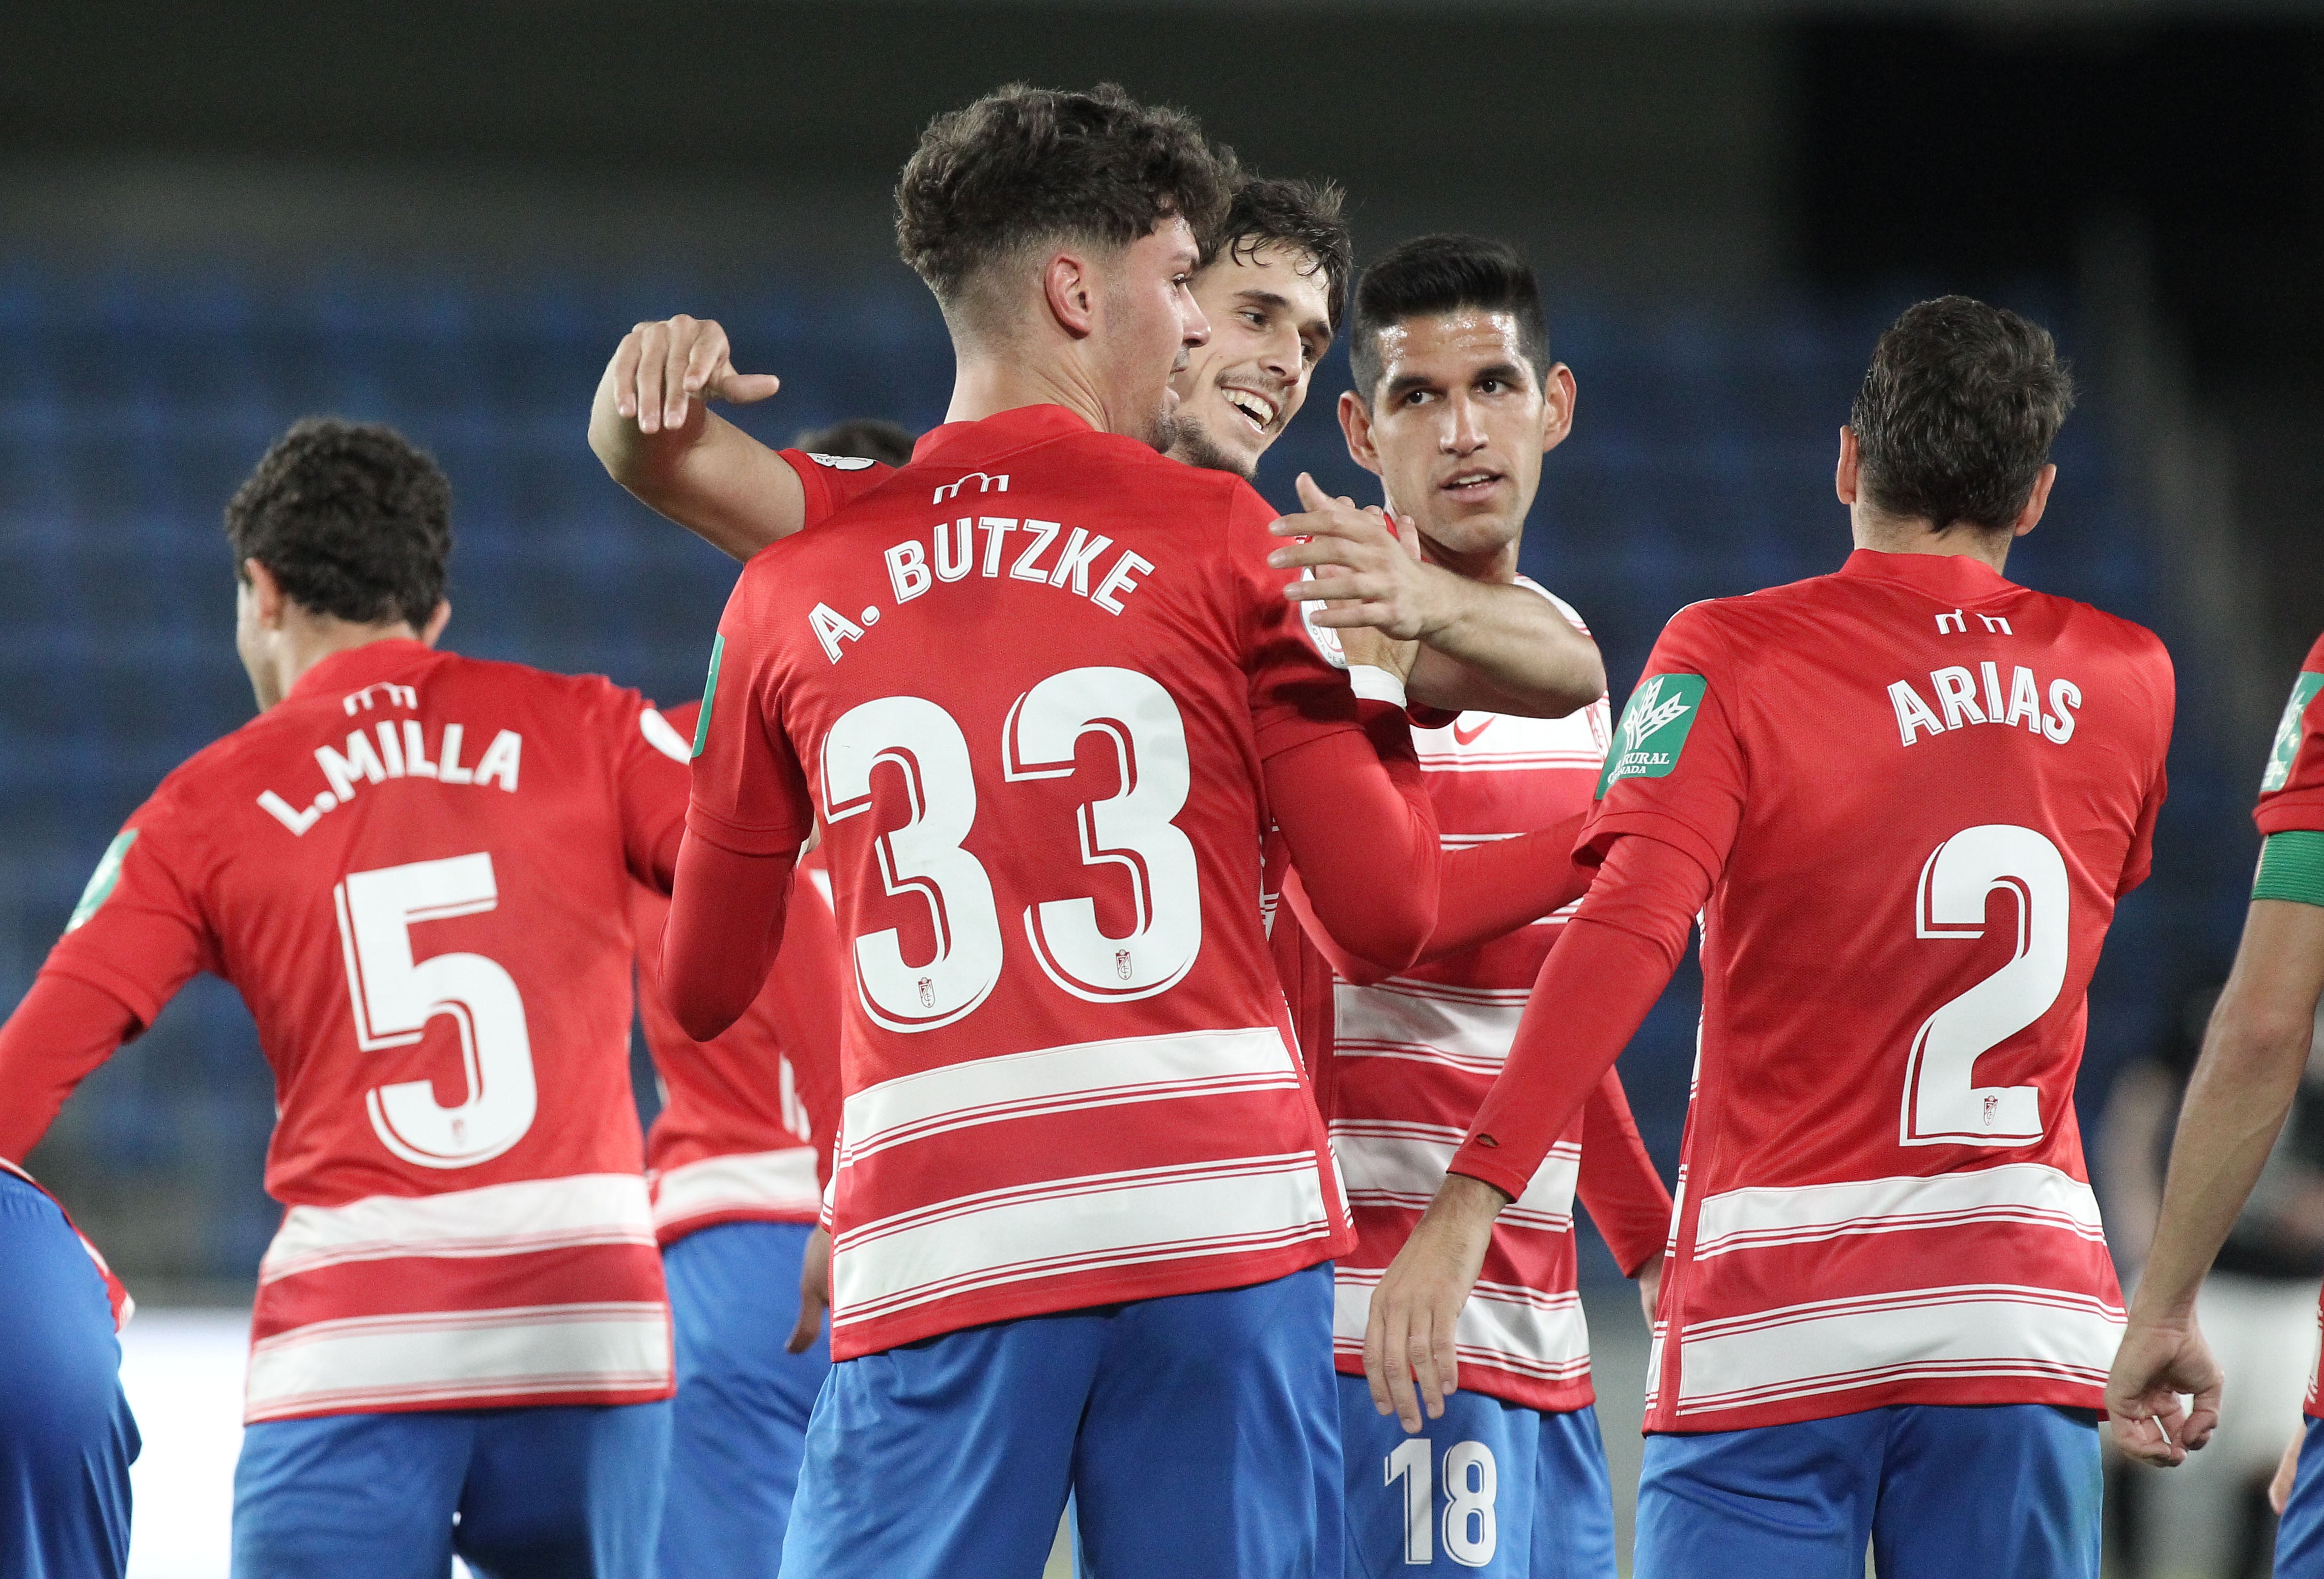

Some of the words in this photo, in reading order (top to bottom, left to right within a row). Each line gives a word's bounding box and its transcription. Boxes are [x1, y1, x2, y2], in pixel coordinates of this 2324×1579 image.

[807, 601, 881, 665] A.
[884, 516, 1155, 616] BUTZKE
[1622, 752, 1670, 766] RURAL
[1886, 661, 2082, 747] ARIAS
[819, 666, 1202, 1034] 33
[333, 851, 537, 1170] 5
[1899, 824, 2070, 1147] 2
[1384, 1438, 1497, 1567] 18
